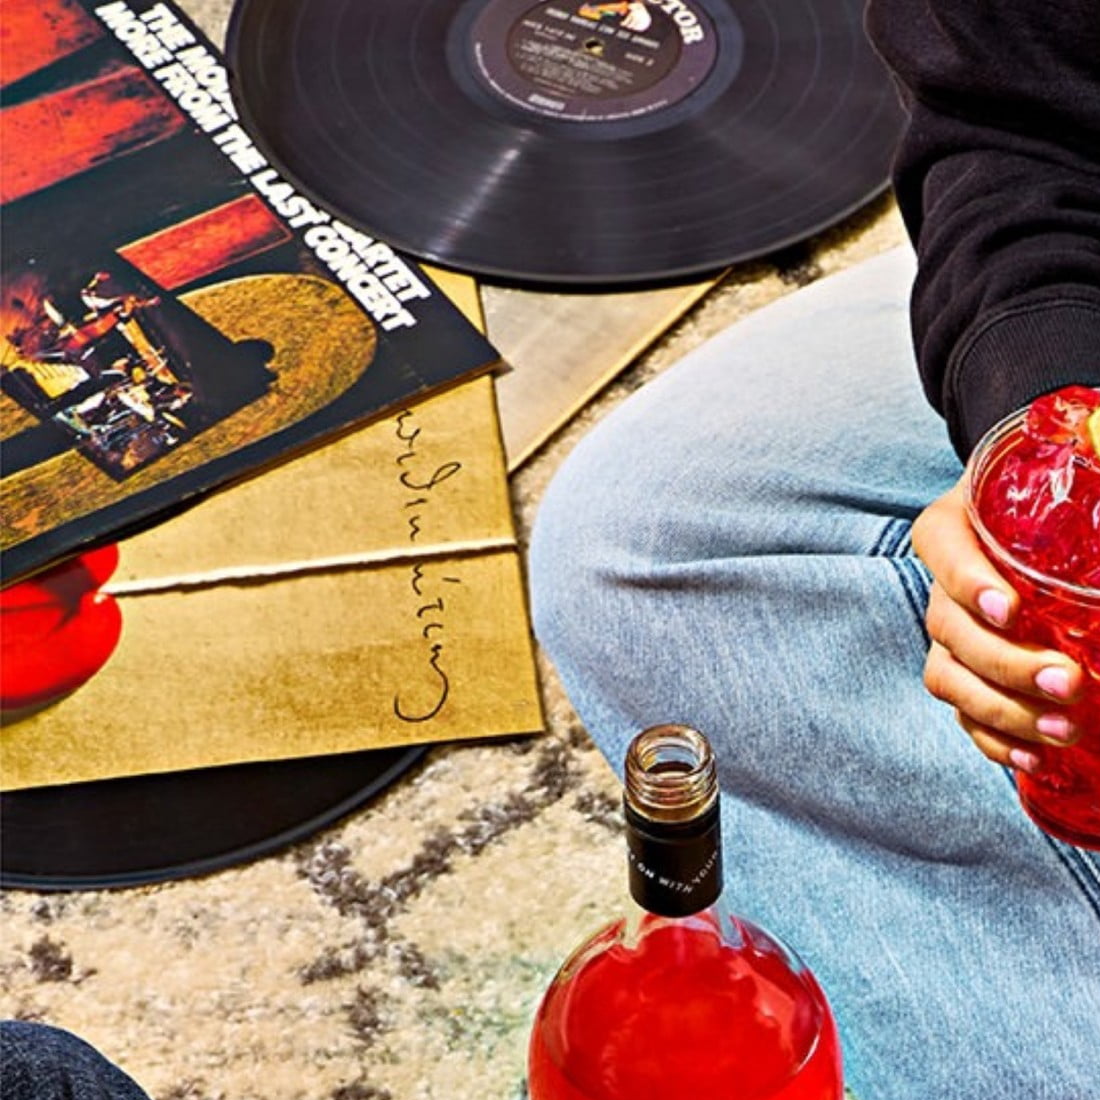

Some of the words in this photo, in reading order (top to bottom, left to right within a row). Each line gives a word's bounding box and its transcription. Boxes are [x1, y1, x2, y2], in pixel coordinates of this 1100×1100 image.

[139, 2, 196, 51] THE
[94, 0, 175, 69] MORE
[152, 62, 232, 133] FROM
[212, 123, 268, 175] THE
[250, 168, 331, 229] LAST
[304, 225, 417, 331] CONCERT
[659, 876, 693, 893] WITH
